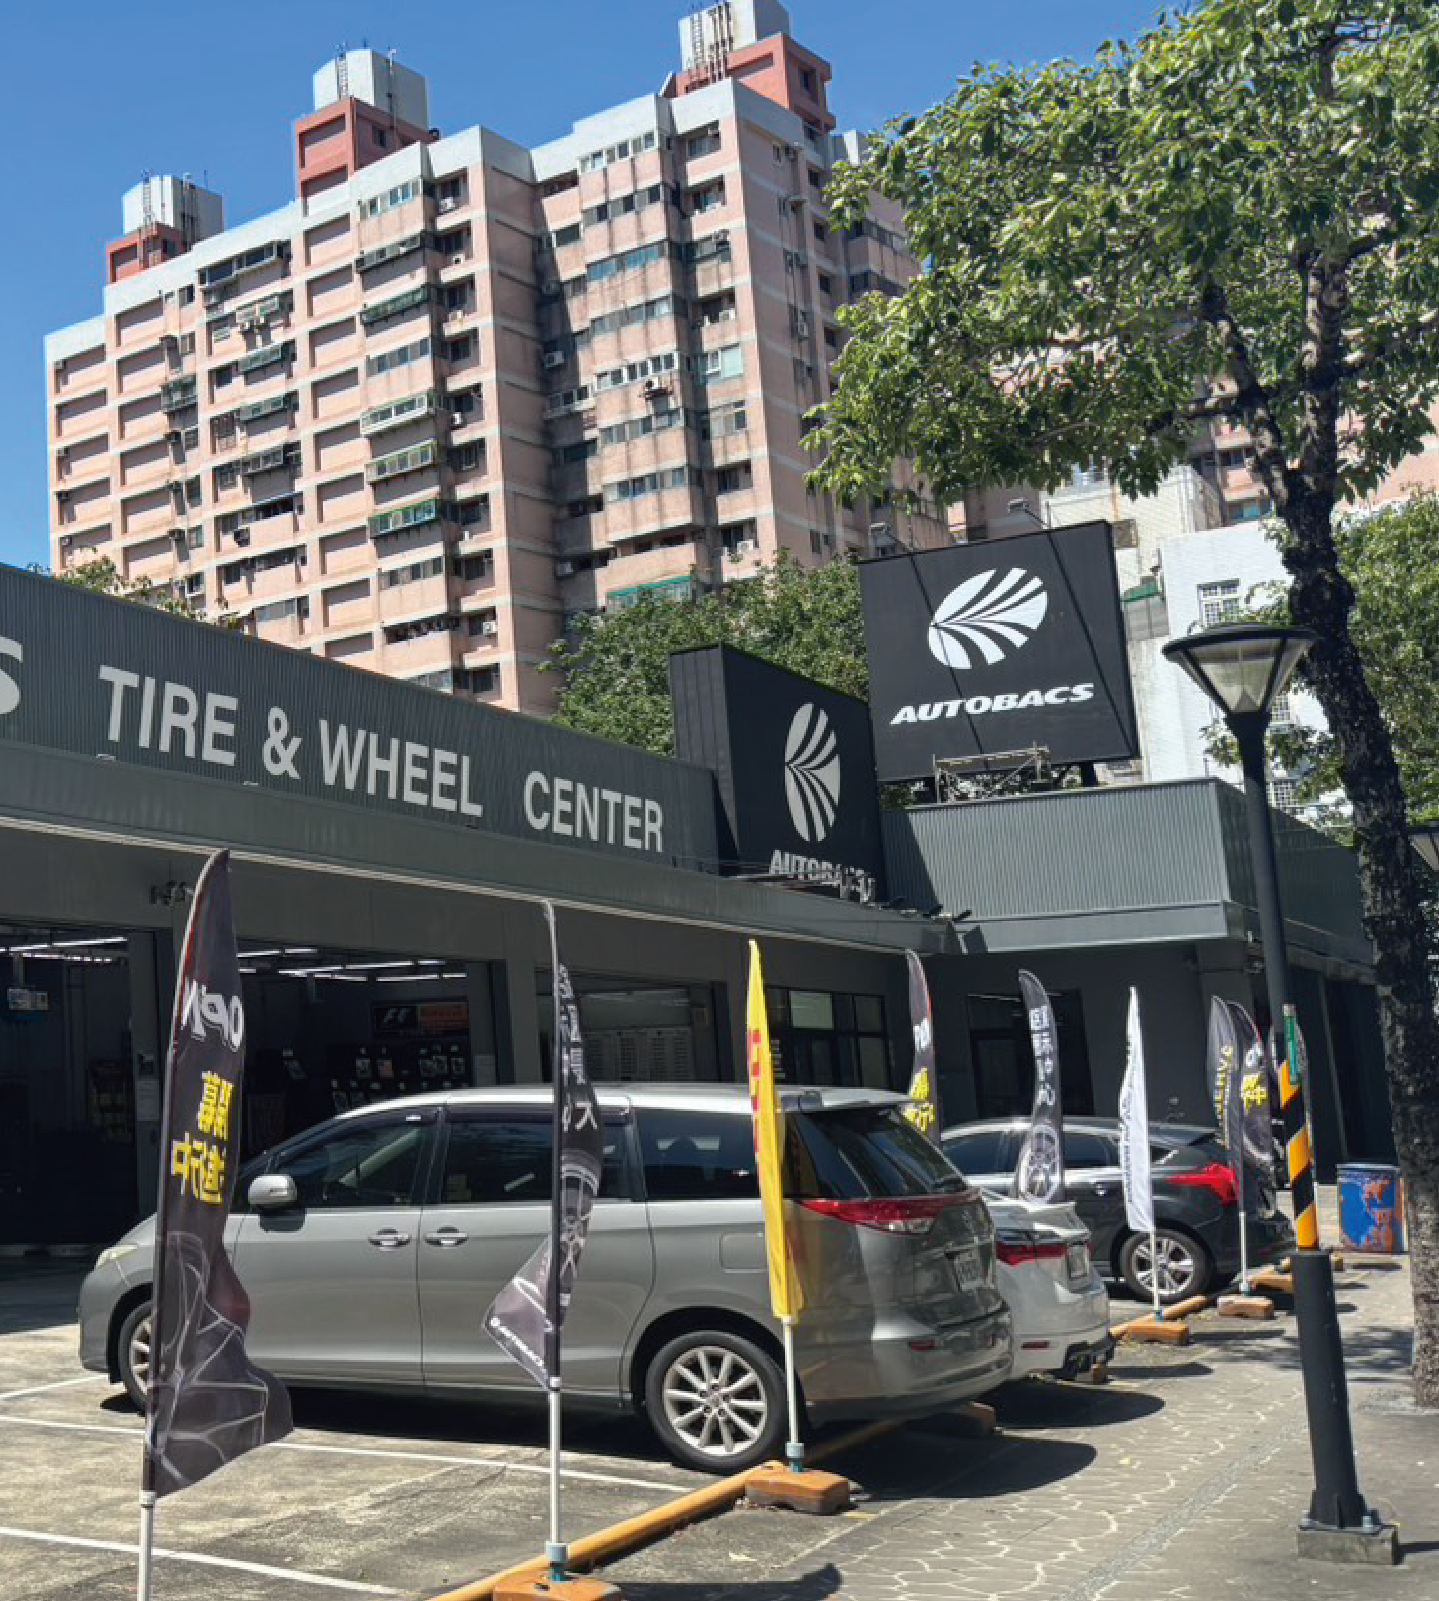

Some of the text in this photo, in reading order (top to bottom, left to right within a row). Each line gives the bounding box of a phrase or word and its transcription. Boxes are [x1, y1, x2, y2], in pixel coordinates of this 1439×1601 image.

[99, 665, 663, 852] TIRE & WHEEL CENTER
[889, 683, 1094, 725] AUTOBACS
